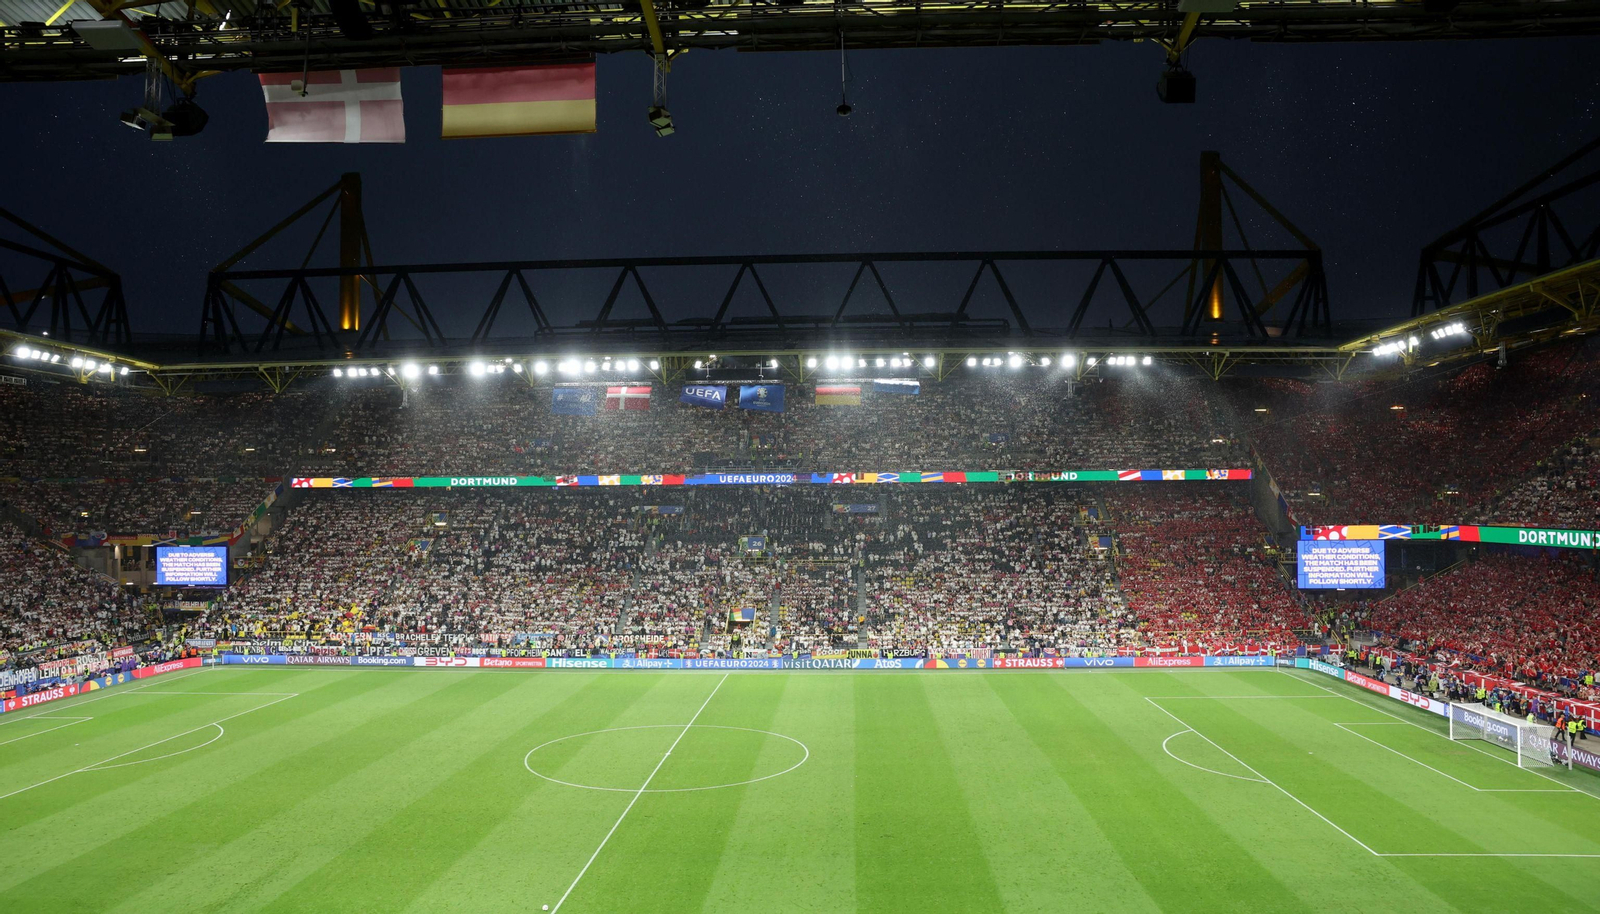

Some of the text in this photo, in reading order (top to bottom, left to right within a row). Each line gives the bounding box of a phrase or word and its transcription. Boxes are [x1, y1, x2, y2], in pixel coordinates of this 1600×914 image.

[686, 388, 721, 400] UEFA
[418, 648, 451, 656] GREVEN
[288, 656, 314, 664] QATAR
[358, 657, 406, 665] Booking.com
[426, 657, 467, 666] BYD
[484, 658, 512, 666] Betano
[552, 658, 607, 668] Hisense
[1006, 659, 1053, 667] STRAUSS
[1148, 658, 1191, 666] AliExpress
[153, 662, 184, 674] AliExpress
[1309, 658, 1339, 677] Hisense
[22, 688, 64, 706] STRAUSS
[1401, 690, 1430, 709] BYD
